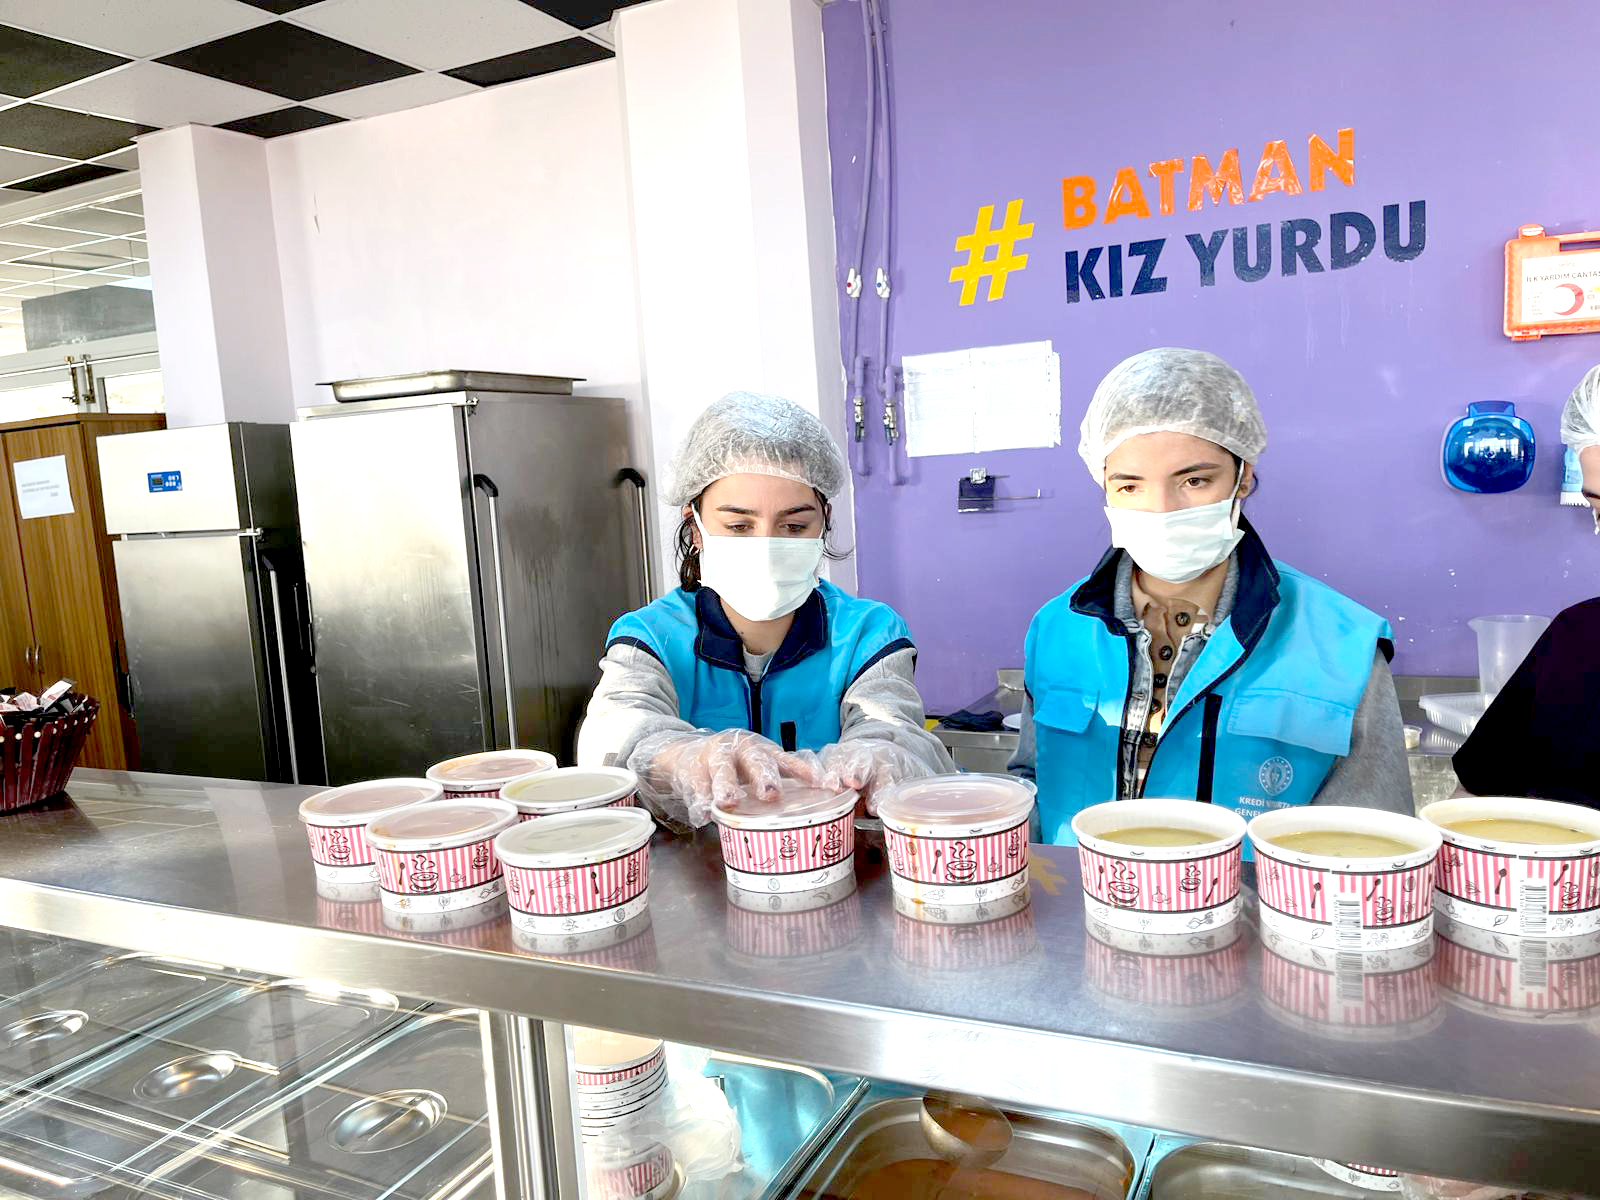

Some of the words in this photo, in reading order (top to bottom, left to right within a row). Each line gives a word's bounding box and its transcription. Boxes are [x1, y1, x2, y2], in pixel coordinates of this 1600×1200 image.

[1061, 127, 1355, 231] BATMAN
[1065, 238, 1168, 304] KIZ
[1185, 199, 1426, 287] YURDU
[1540, 273, 1570, 281] YARDIM
